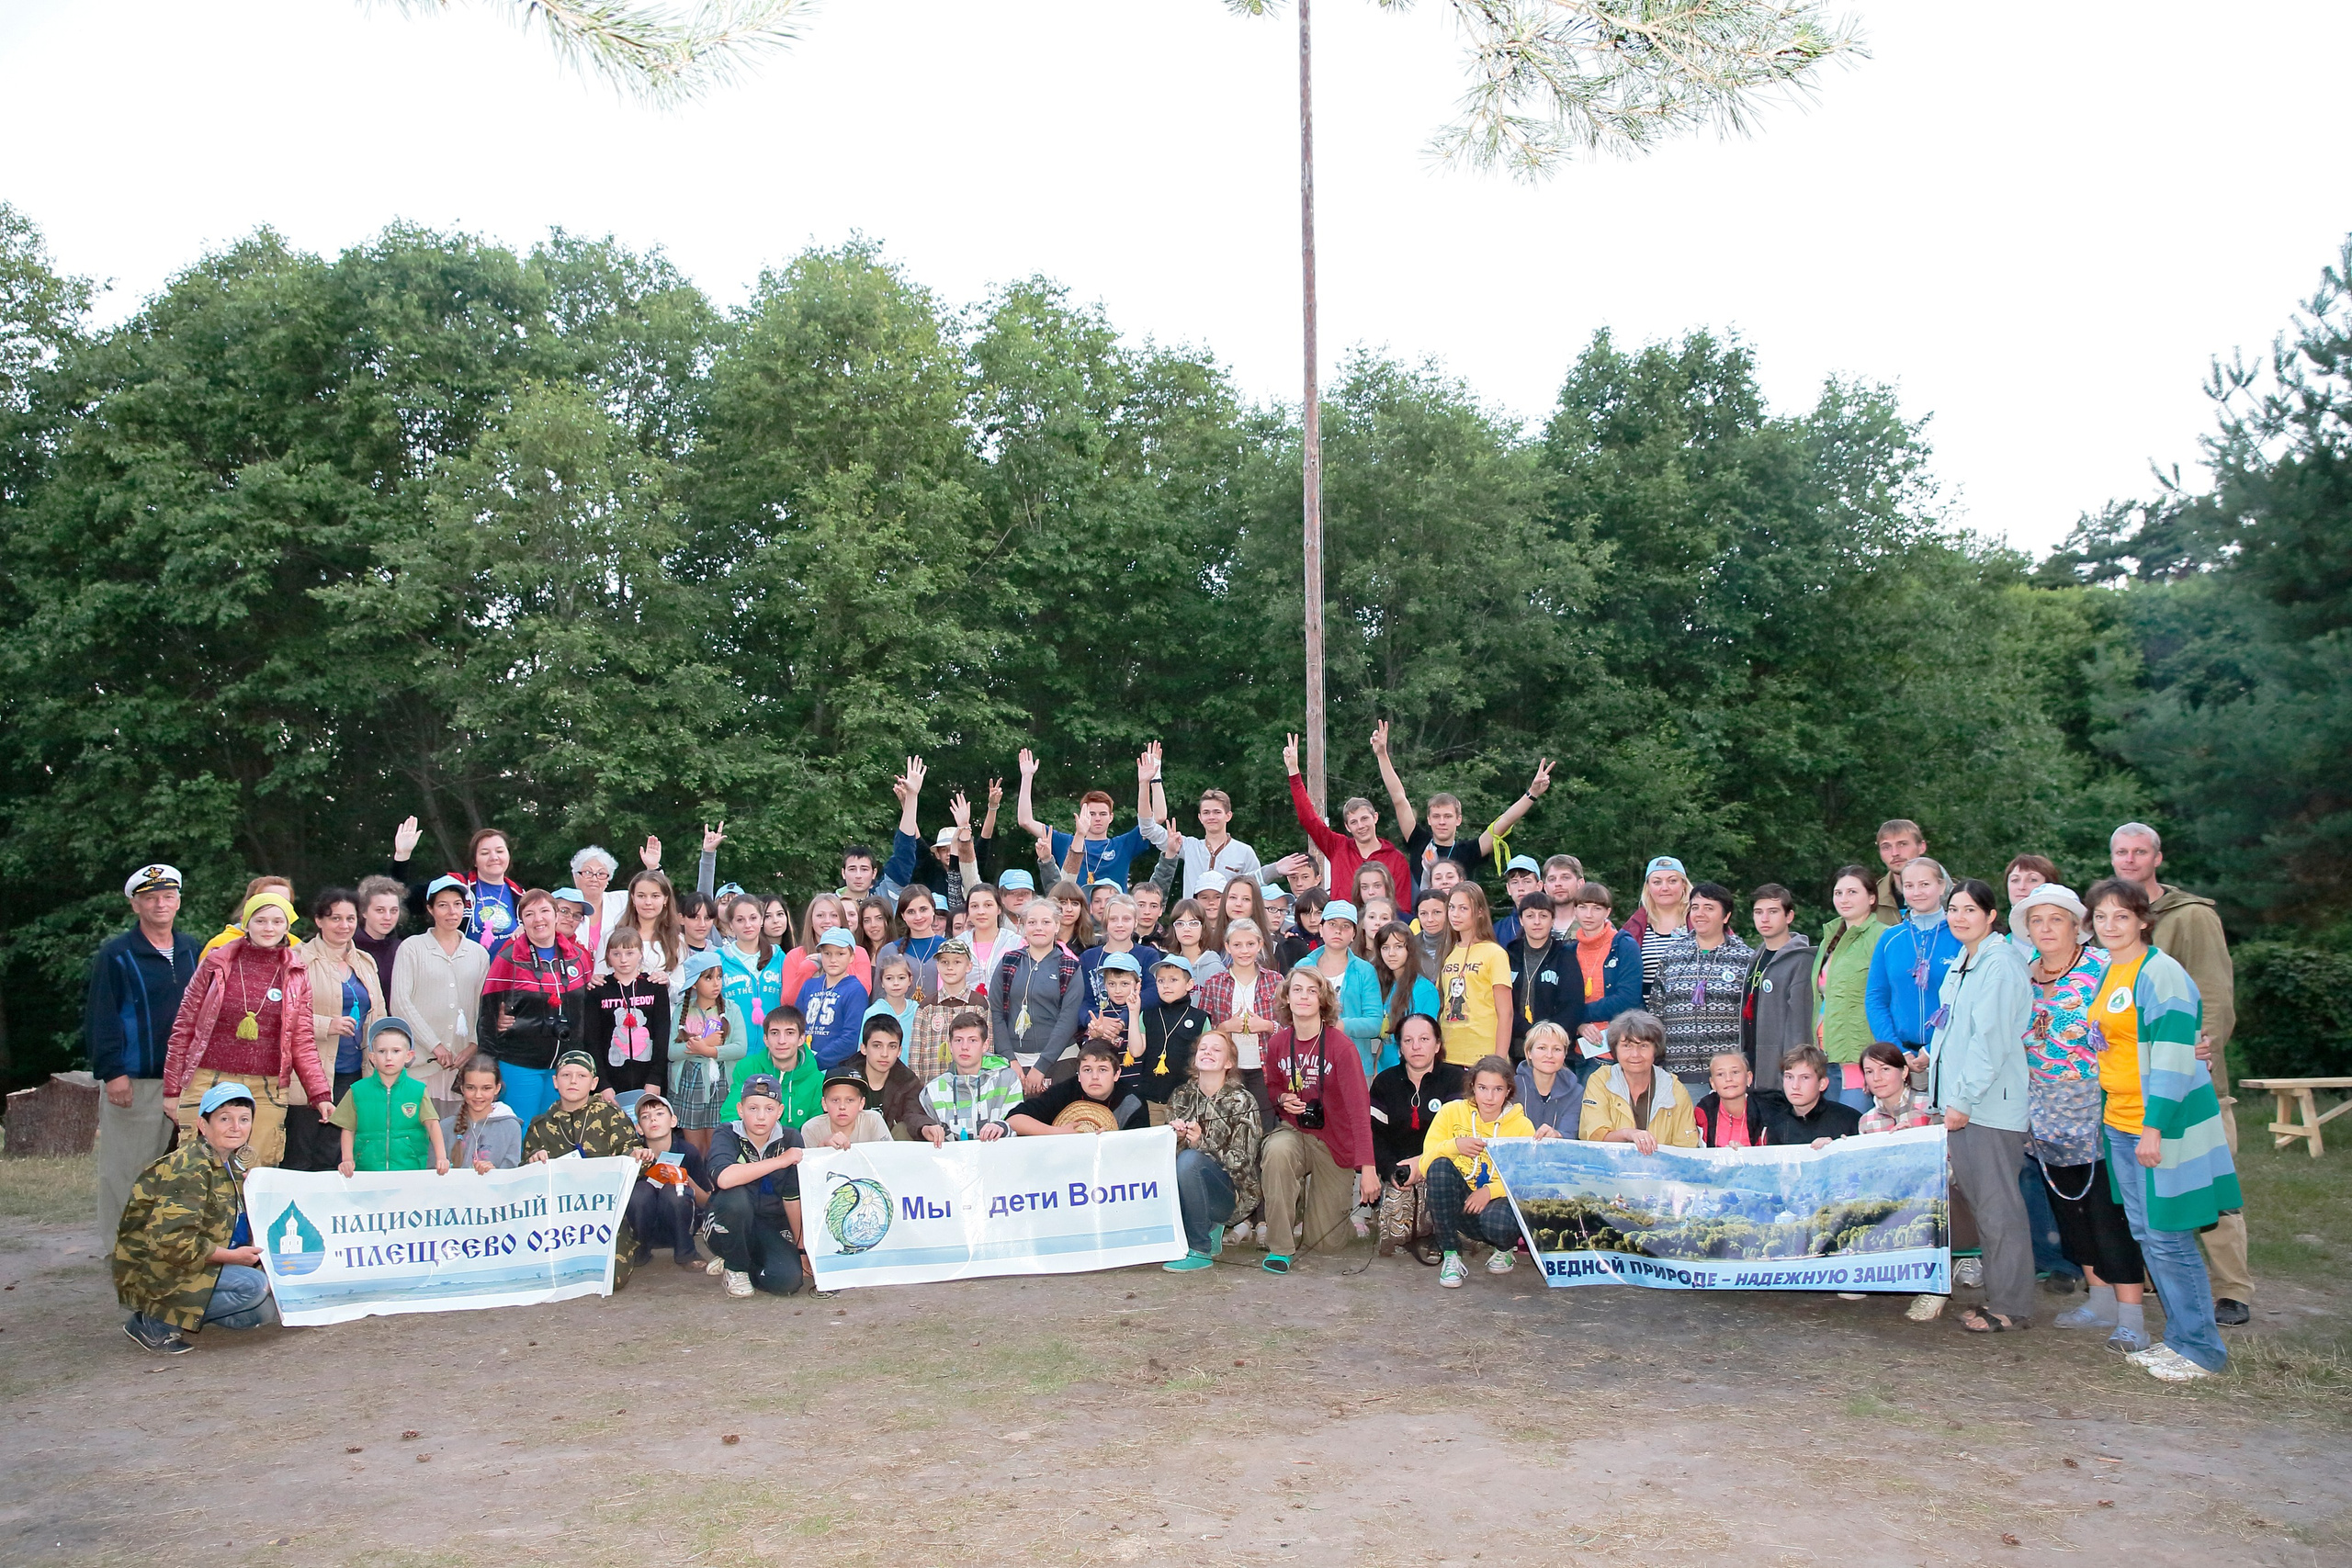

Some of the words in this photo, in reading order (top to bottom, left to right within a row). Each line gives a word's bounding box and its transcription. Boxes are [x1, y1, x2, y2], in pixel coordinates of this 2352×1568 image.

[629, 994, 655, 1007] TEDDY
[737, 987, 752, 995] THE
[331, 1193, 548, 1236] НАЦИОНАЛЬНЫЙ
[901, 1195, 952, 1221] Мы
[989, 1190, 1058, 1219] дети
[1068, 1180, 1159, 1207] Волги
[526, 1223, 612, 1253] ОЗЕРО
[1544, 1256, 1625, 1279] ВЕДНОЙ
[1630, 1260, 1718, 1289] ПРИРОДЕ
[1735, 1269, 1849, 1287] НАДЕЖНУЮ
